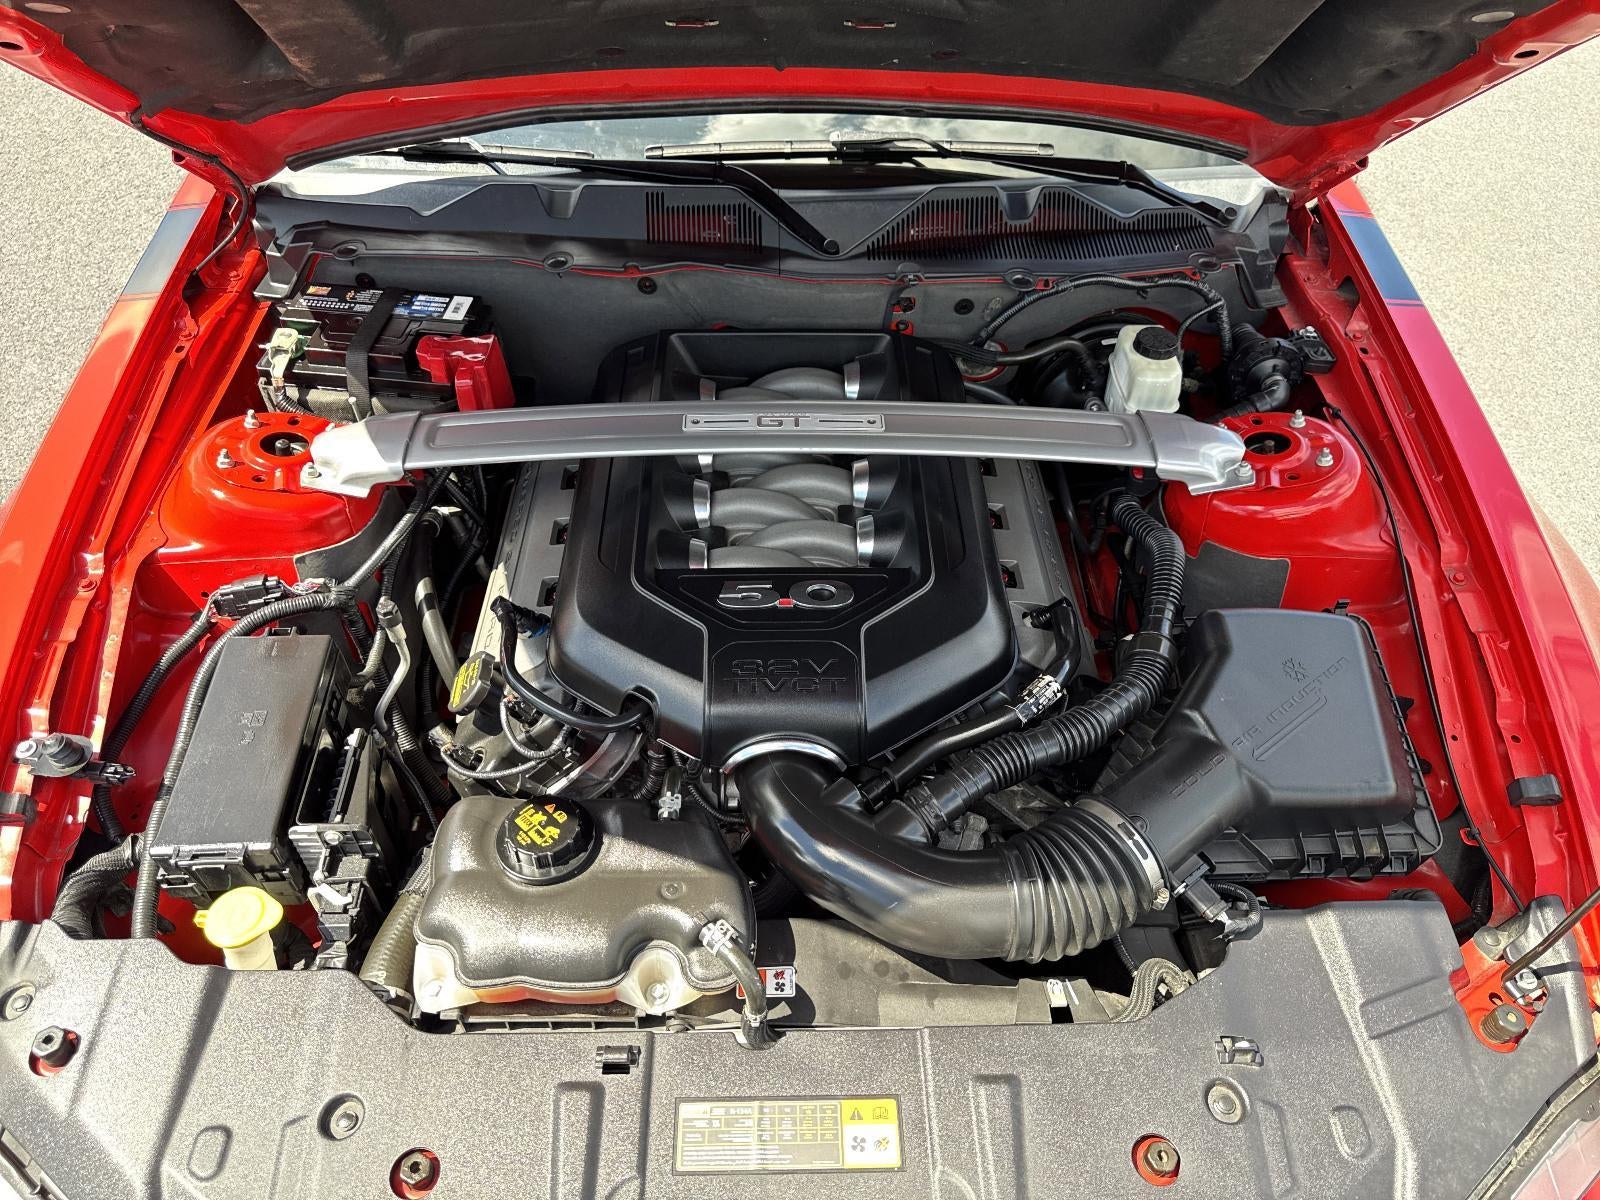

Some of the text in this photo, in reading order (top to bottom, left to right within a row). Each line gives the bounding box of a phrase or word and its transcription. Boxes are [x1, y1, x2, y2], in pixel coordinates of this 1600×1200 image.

[757, 415, 811, 428] GT
[717, 580, 855, 609] 5.0
[731, 658, 840, 676] 32V
[1169, 753, 1227, 800] COLD
[1232, 725, 1262, 751] AIR
